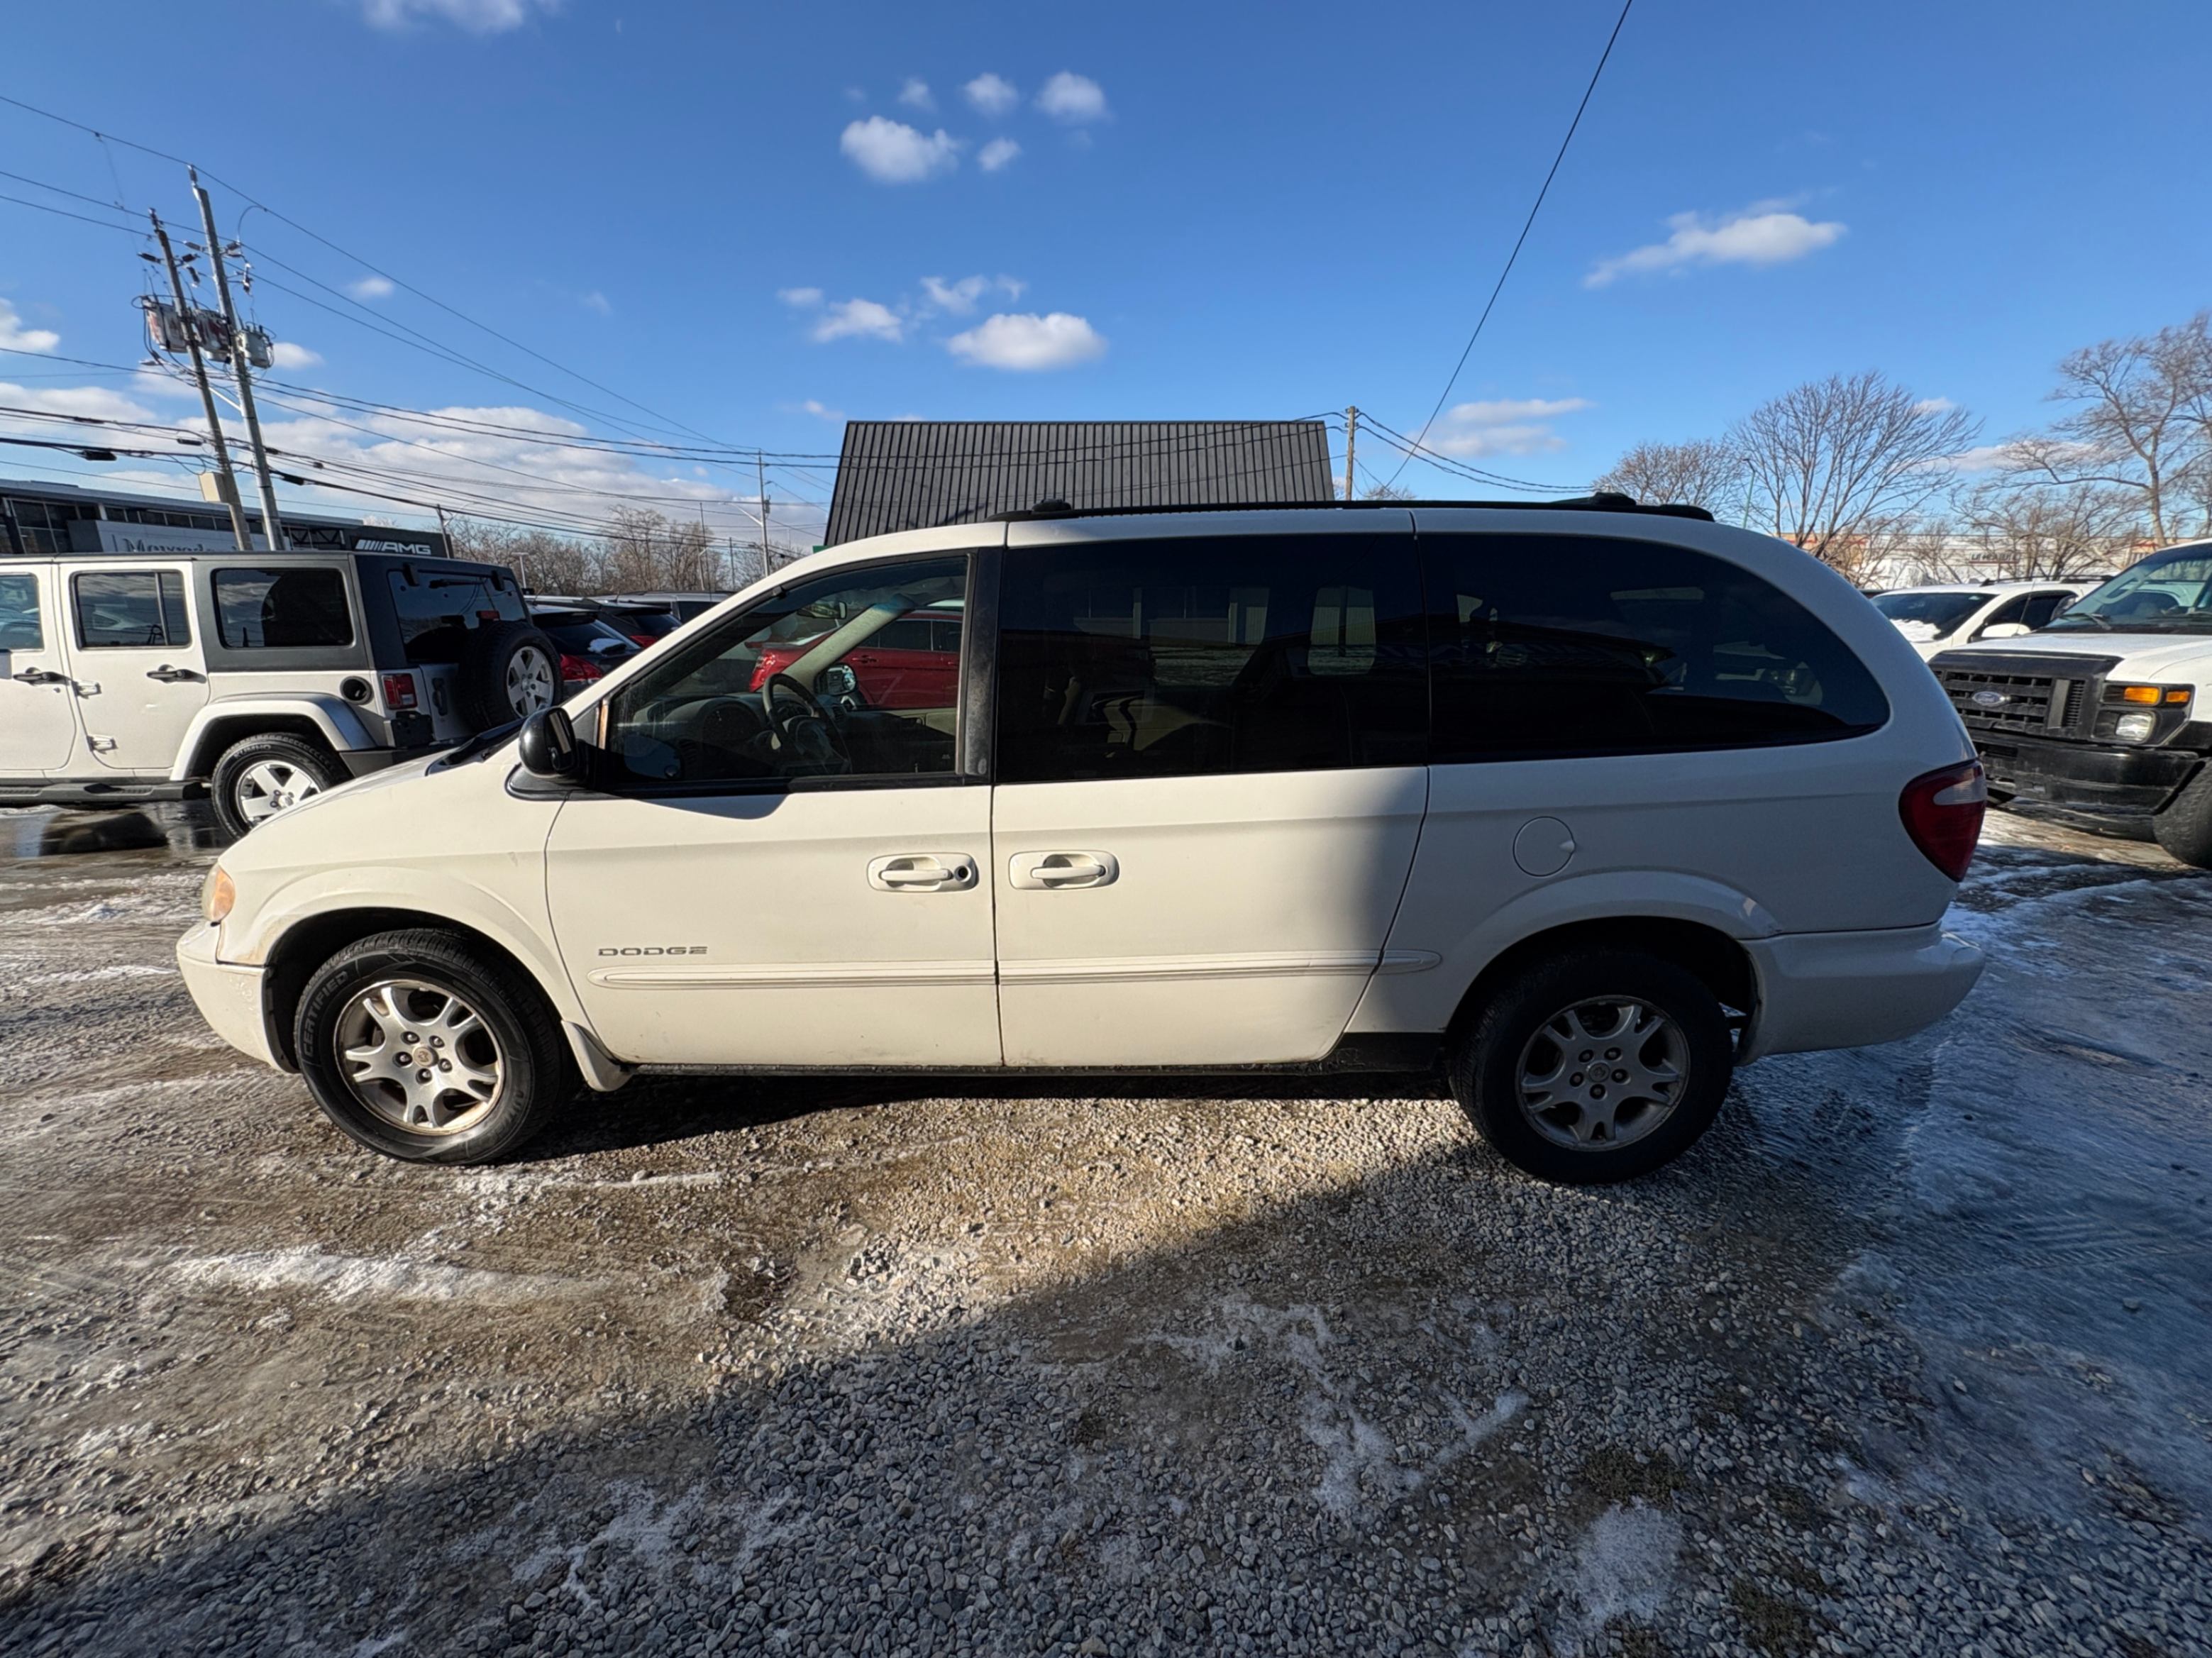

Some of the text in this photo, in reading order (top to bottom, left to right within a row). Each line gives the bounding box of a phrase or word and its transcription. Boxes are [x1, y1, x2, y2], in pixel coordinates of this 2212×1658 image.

[382, 541, 431, 555] AMG
[598, 946, 708, 956] DODGE
[303, 971, 349, 1057] CERTIFIED
